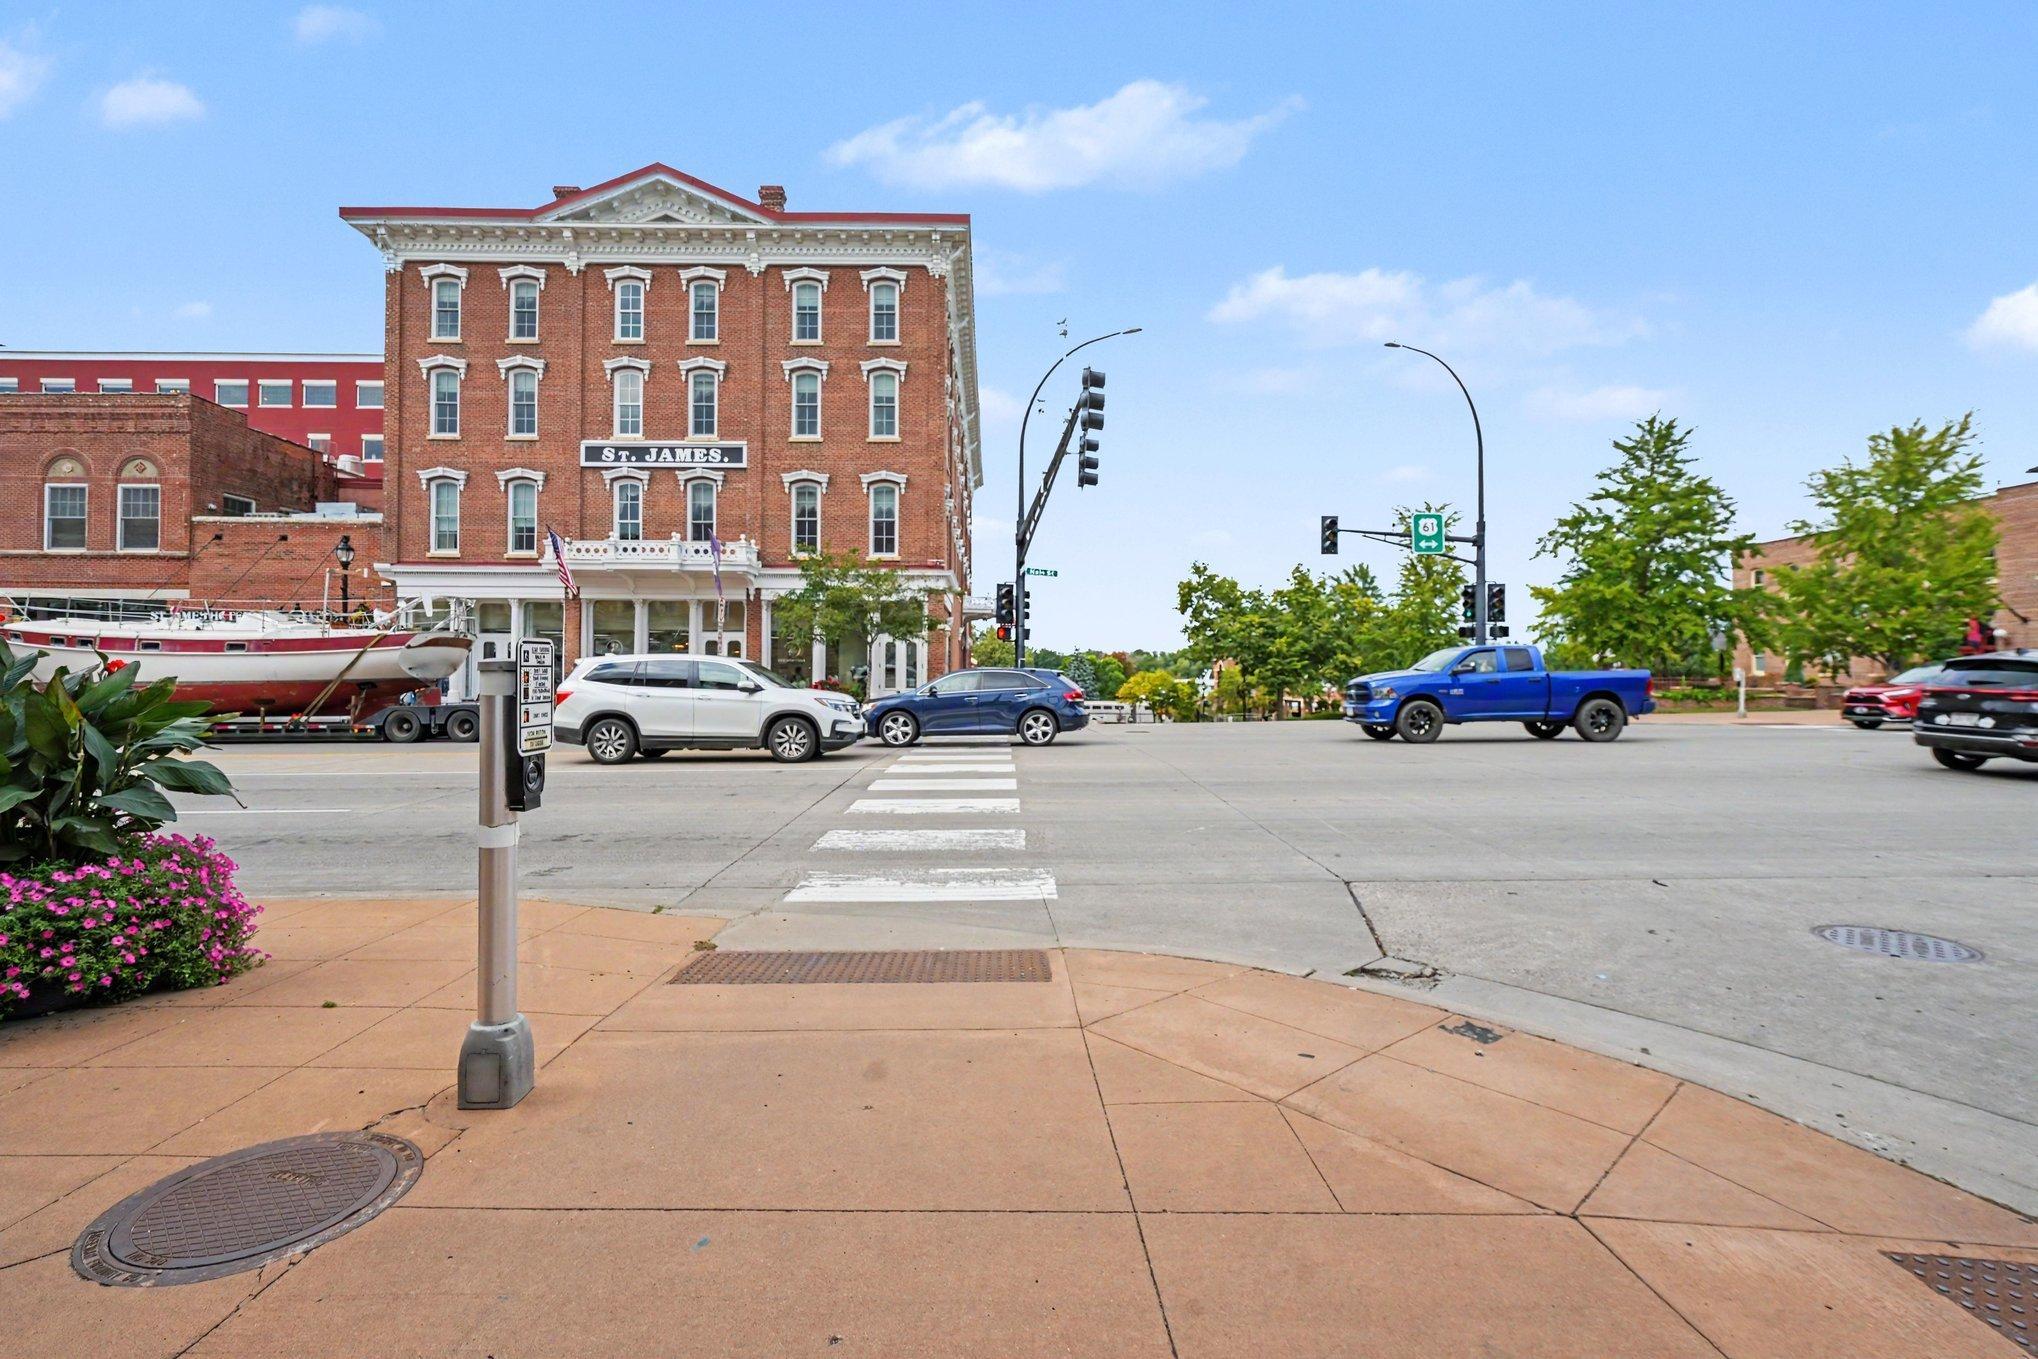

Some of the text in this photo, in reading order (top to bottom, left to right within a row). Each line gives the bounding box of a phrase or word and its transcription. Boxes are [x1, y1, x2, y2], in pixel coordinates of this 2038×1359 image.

[601, 447, 729, 463] ST. JAMES.
[1422, 522, 1435, 532] 61
